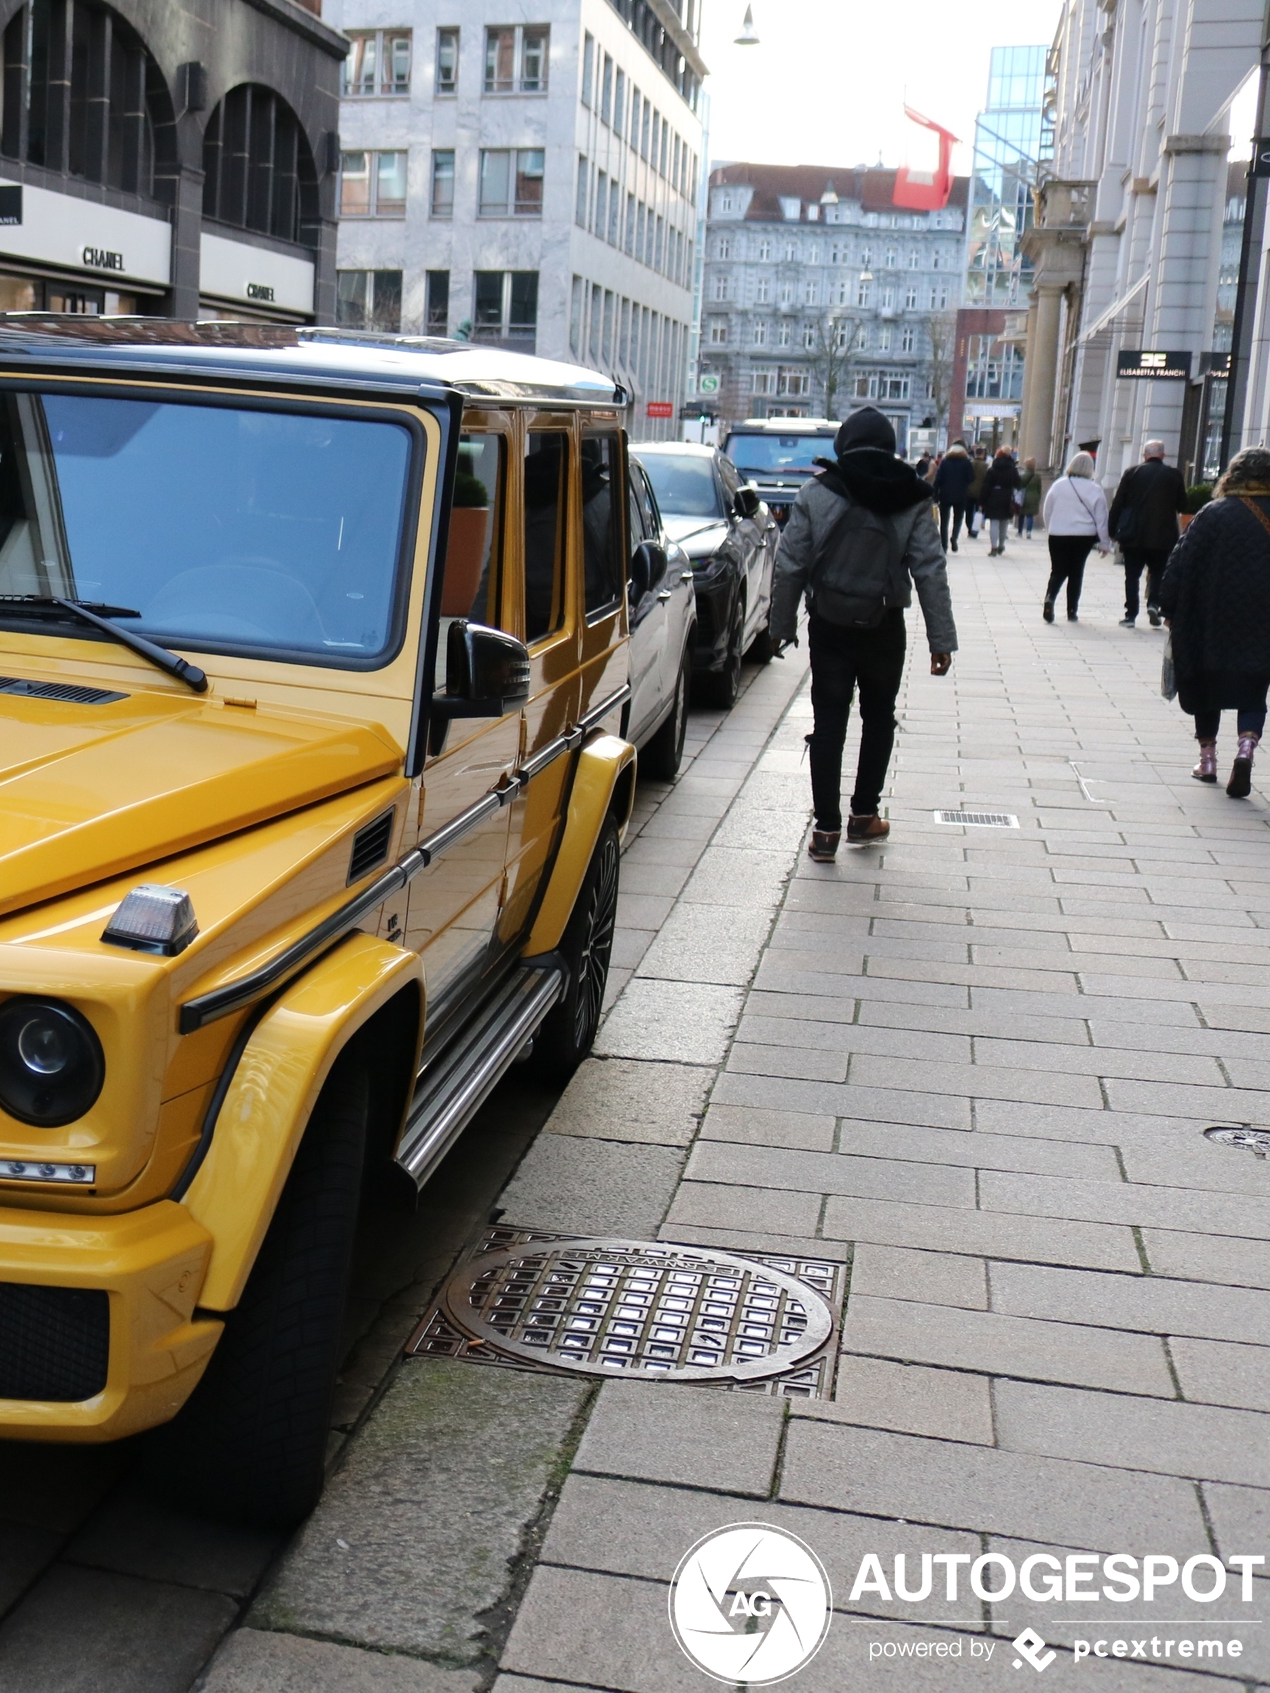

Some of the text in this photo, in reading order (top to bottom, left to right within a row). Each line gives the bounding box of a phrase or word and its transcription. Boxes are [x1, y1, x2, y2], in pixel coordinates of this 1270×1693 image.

[83, 246, 125, 271] CHANEL
[1119, 368, 1186, 378] ELISABETTA FRANCHI
[703, 377, 717, 392] S
